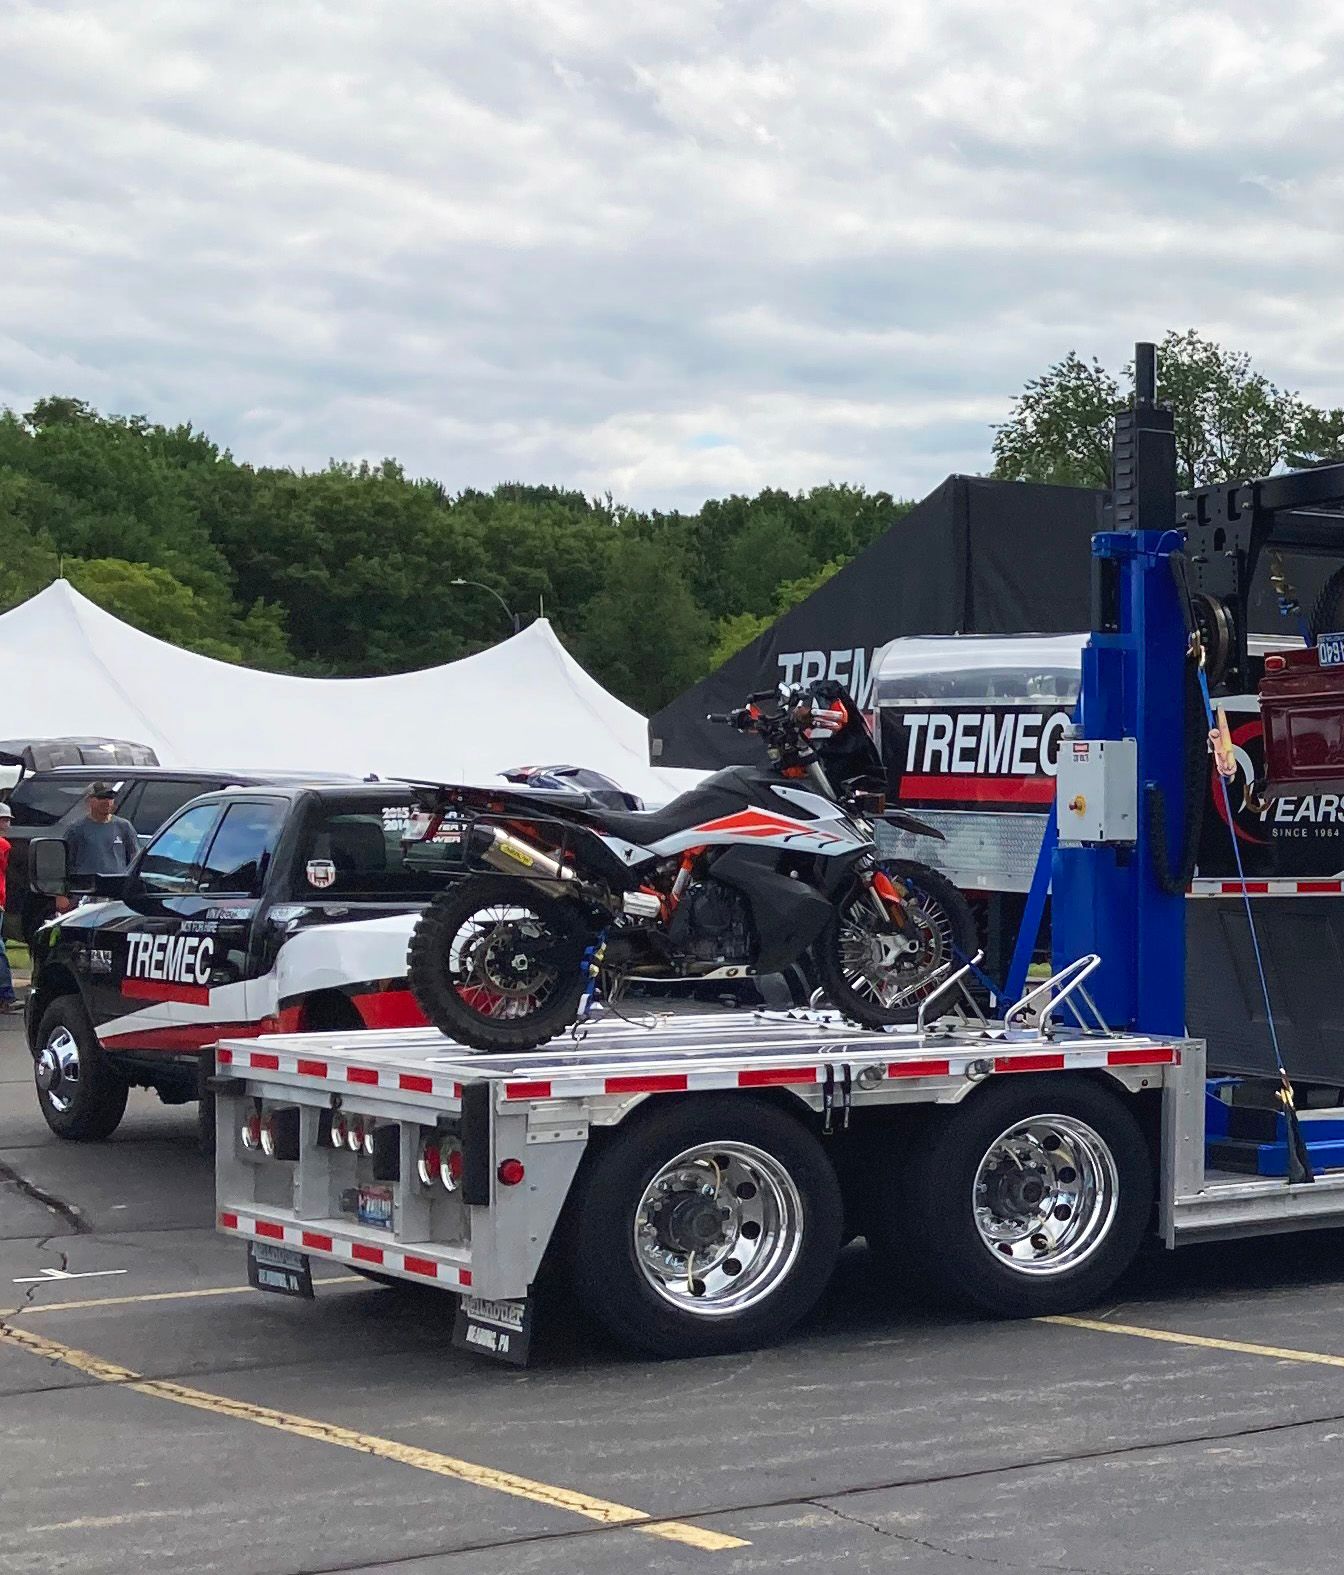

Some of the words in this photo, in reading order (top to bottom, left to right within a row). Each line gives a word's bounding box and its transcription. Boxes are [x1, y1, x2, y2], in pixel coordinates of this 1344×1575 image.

[903, 712, 1071, 776] TREMEC
[1272, 828, 1308, 838] SINCE
[126, 932, 214, 985] TREMEC
